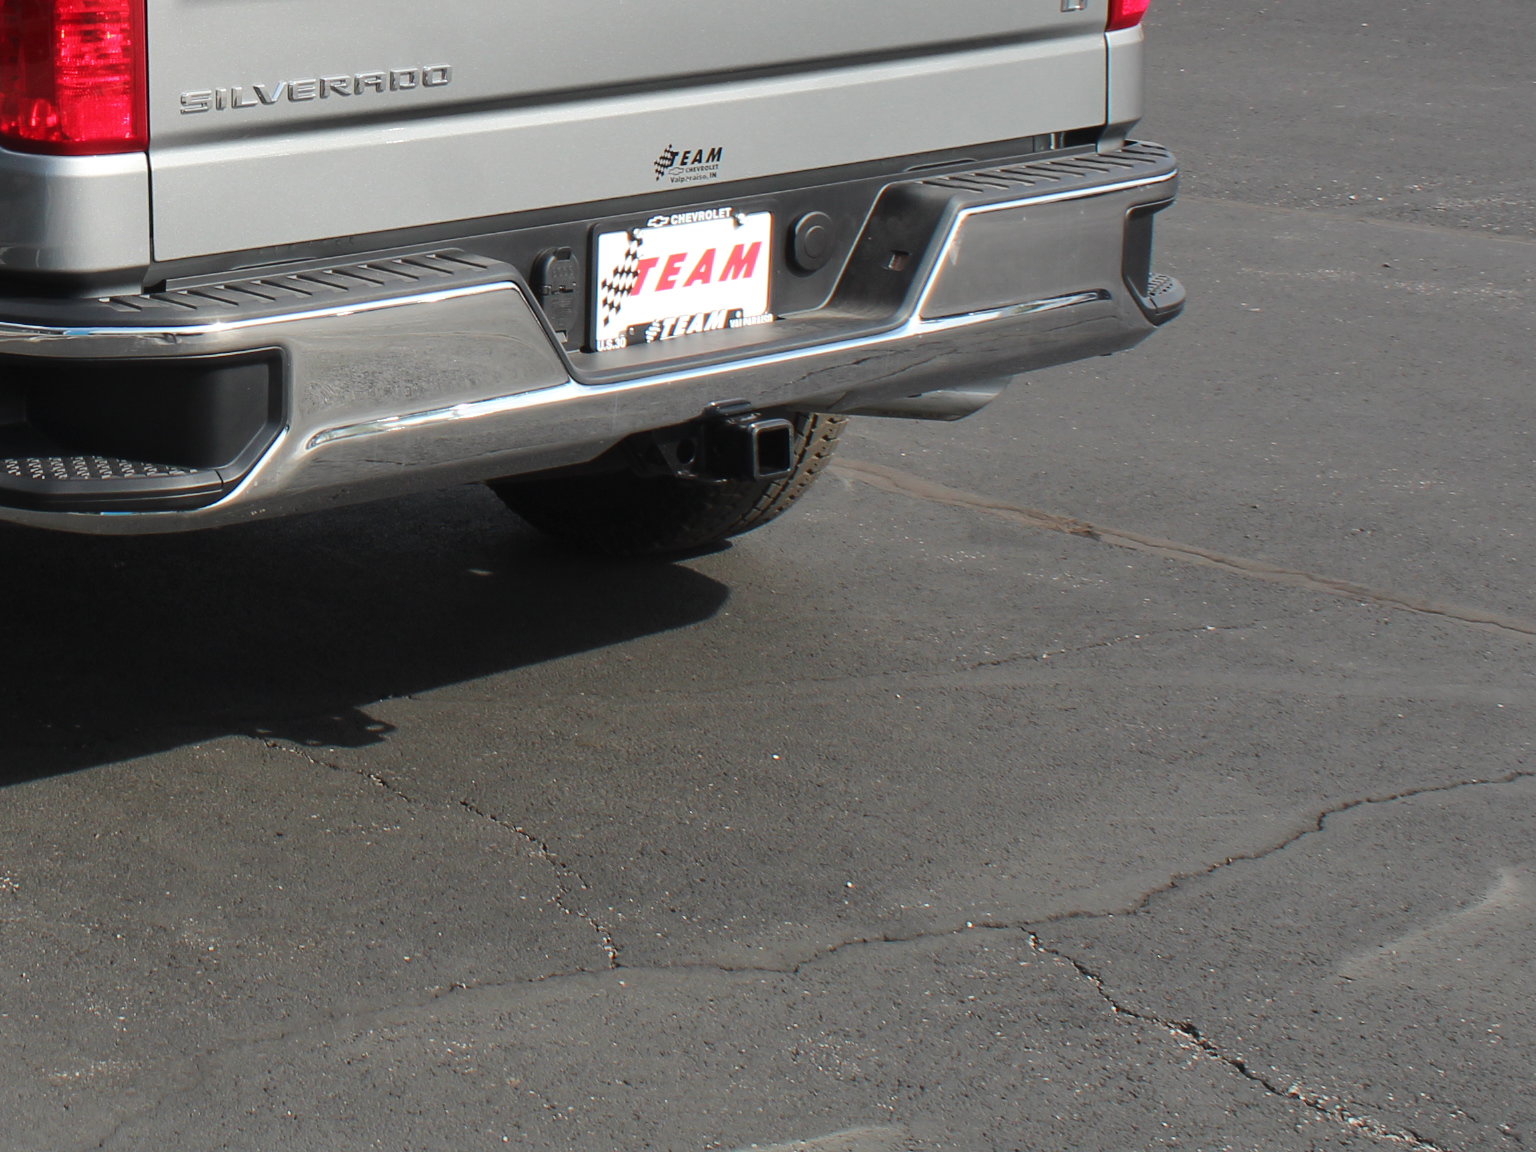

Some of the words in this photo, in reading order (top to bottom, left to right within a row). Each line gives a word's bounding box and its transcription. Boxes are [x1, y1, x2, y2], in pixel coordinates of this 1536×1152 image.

[179, 63, 453, 115] SILVERADO
[669, 147, 723, 166] TEAM
[685, 164, 719, 173] CHEVROLET
[670, 207, 732, 225] CHEVROLET
[630, 241, 763, 296] TEAM
[659, 308, 729, 341] TEAM
